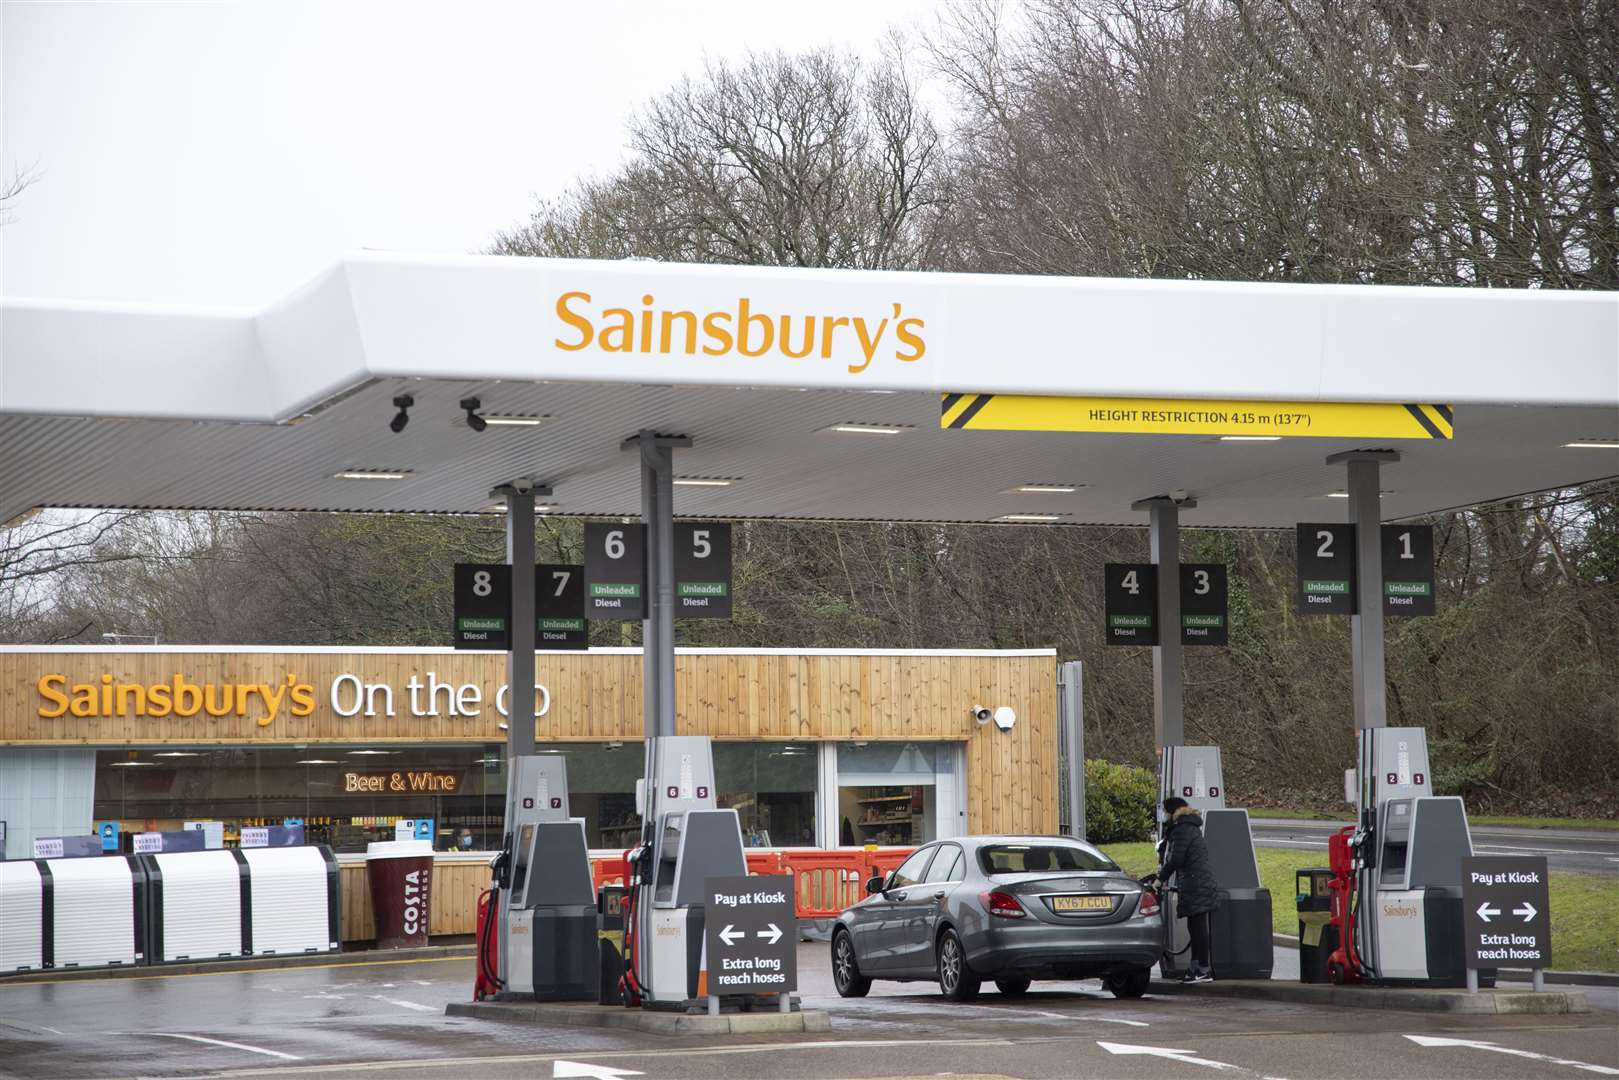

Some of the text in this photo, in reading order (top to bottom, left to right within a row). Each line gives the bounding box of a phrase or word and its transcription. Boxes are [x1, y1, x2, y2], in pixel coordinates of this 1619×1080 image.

[555, 290, 926, 374] Sainsbury's
[1089, 409, 1138, 421] HEIGHT
[1142, 410, 1228, 423] RESTRICTION
[1231, 413, 1255, 424] 4.15
[1258, 415, 1271, 424] m
[604, 530, 625, 559] 6
[692, 530, 711, 558] 5
[1316, 530, 1334, 557] 2
[1398, 533, 1414, 559] 1
[473, 570, 492, 596] 8
[552, 571, 571, 596] 7
[1121, 570, 1139, 594] 4
[1194, 570, 1210, 595] 3
[1308, 583, 1345, 592] Unleaded
[1389, 584, 1425, 593] Unleaded
[595, 585, 634, 595] Unleaded
[683, 585, 722, 594] Unleaded
[595, 599, 621, 608] Diesel
[683, 598, 708, 607] Diesel
[1308, 595, 1332, 604] Diesel
[1389, 596, 1413, 605] Diesel
[463, 620, 500, 629] Unleaded
[543, 620, 579, 629] Unleaded
[1114, 617, 1147, 625] Unleaded
[1186, 617, 1219, 625] Unleaded
[463, 631, 487, 640] Diesel
[543, 631, 566, 640] Diesel
[1114, 628, 1136, 636] Diesel
[1186, 628, 1208, 636] Diesel
[37, 673, 316, 727] Sainsbury's
[330, 674, 396, 717] On
[406, 672, 482, 717] the
[345, 772, 456, 792] Beer & Wine
[1471, 872, 1540, 886] Pay at Kiosk
[404, 870, 420, 935] COSTA
[714, 892, 786, 907] Pay at Kiosk
[1480, 933, 1536, 947] Extra long
[1476, 948, 1541, 959] reach hoses
[722, 957, 781, 971] Extra long
[718, 972, 786, 985] reach hoses
